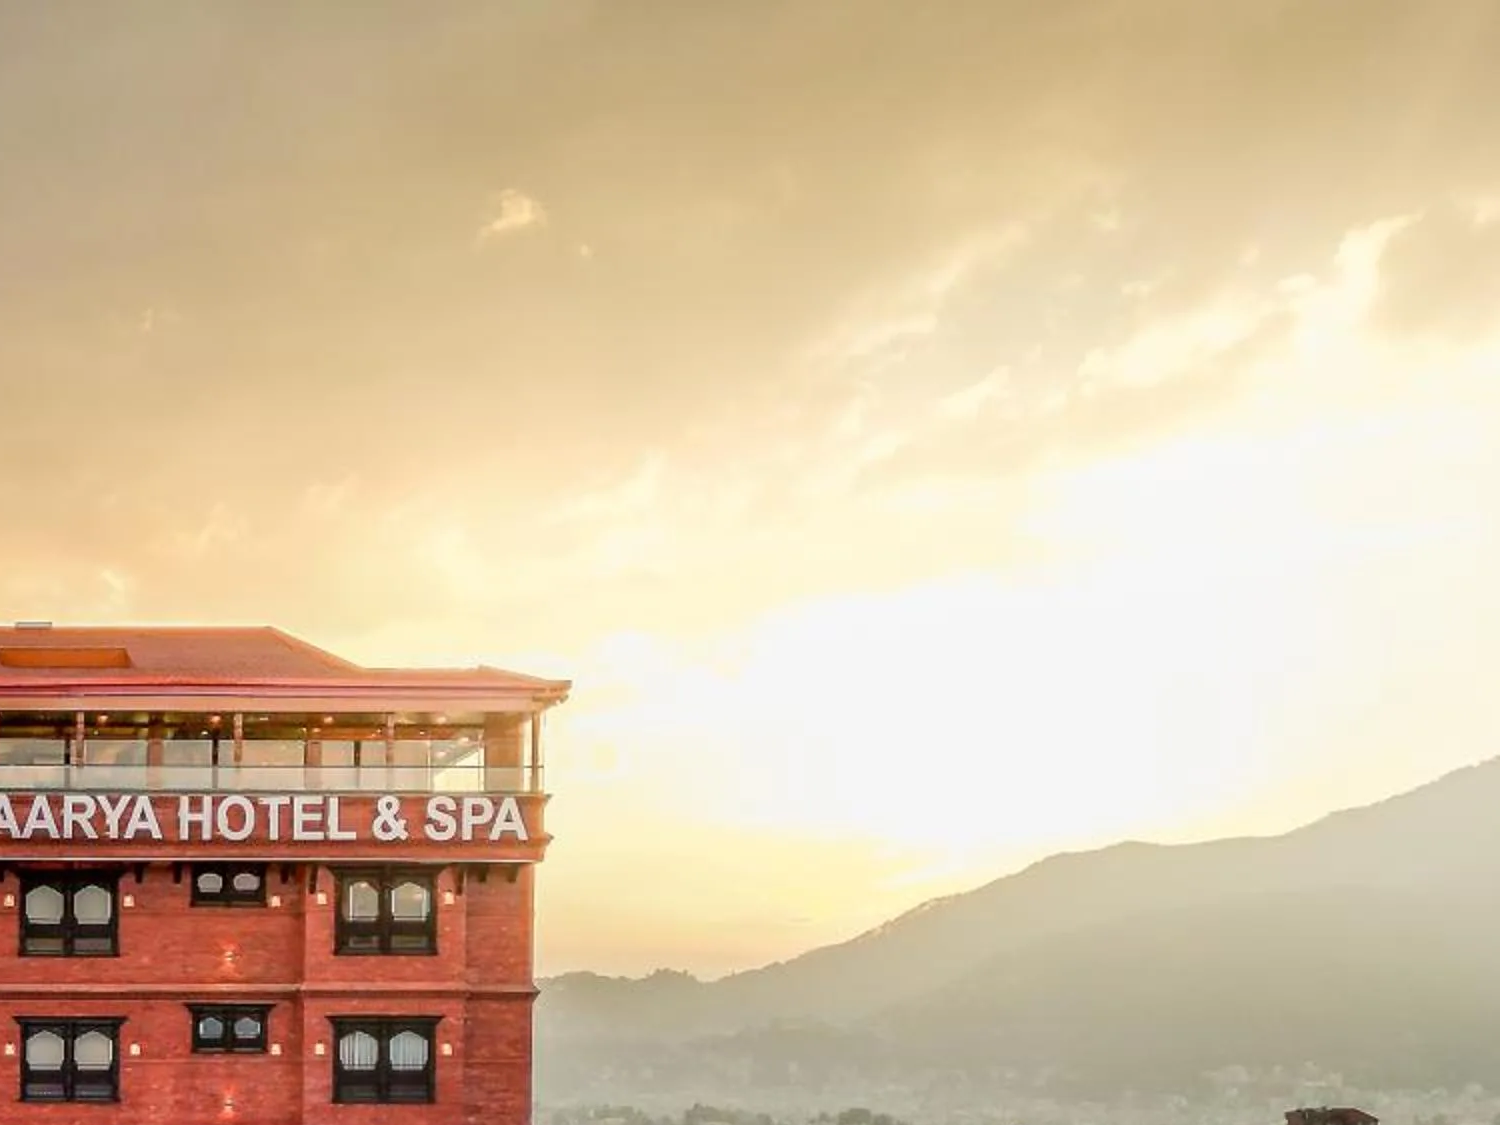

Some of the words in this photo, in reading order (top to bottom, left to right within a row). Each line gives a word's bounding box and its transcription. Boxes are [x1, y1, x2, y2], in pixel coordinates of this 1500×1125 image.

[178, 794, 357, 841] HOTEL
[372, 794, 409, 841] &
[424, 795, 528, 841] SPA
